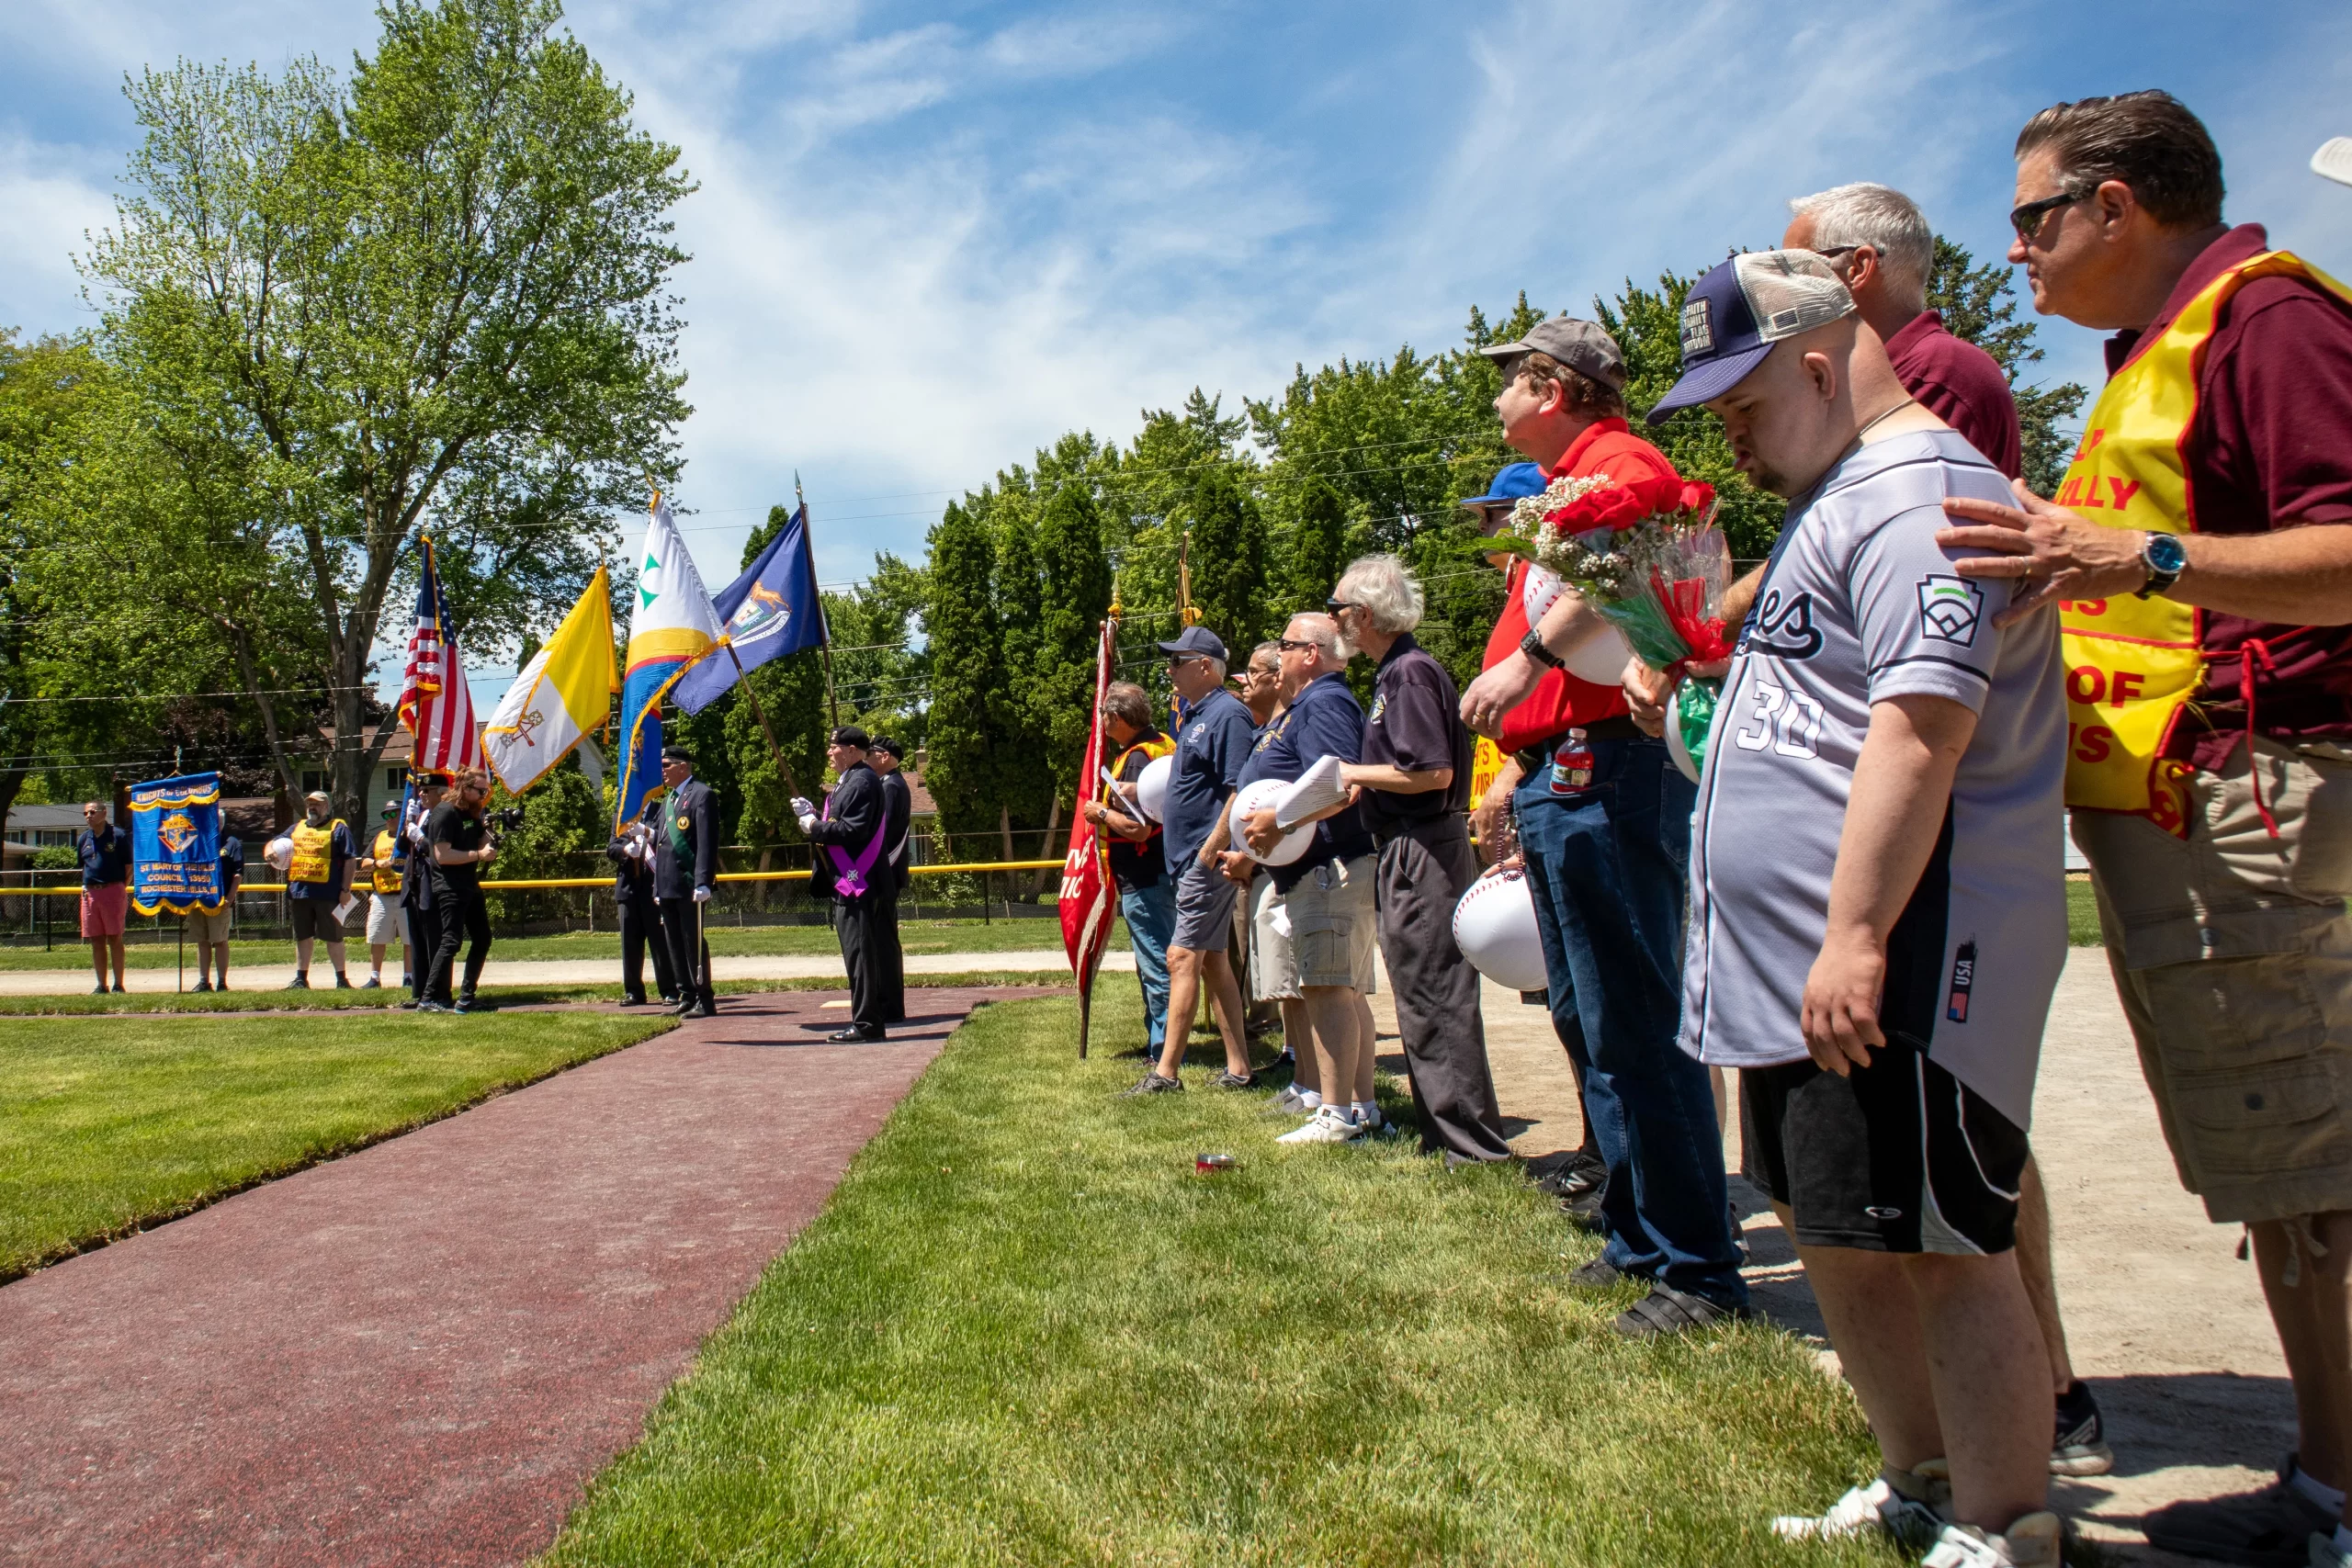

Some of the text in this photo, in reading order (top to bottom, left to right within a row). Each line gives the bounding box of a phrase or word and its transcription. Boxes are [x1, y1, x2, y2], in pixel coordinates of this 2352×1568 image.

[1686, 299, 1706, 316] FAITH
[1690, 323, 1710, 339] FLAG
[2066, 665, 2145, 709] OF
[1735, 679, 1825, 761] 30
[136, 788, 166, 803] KNIGHTS
[175, 784, 212, 797] COLUMBUS
[152, 863, 172, 871] MARY
[173, 863, 184, 872] OF
[198, 863, 216, 872] HILLS
[147, 874, 184, 883] COUNCIL
[141, 885, 187, 894] ROCHESTER
[1954, 960, 1973, 986] USA
